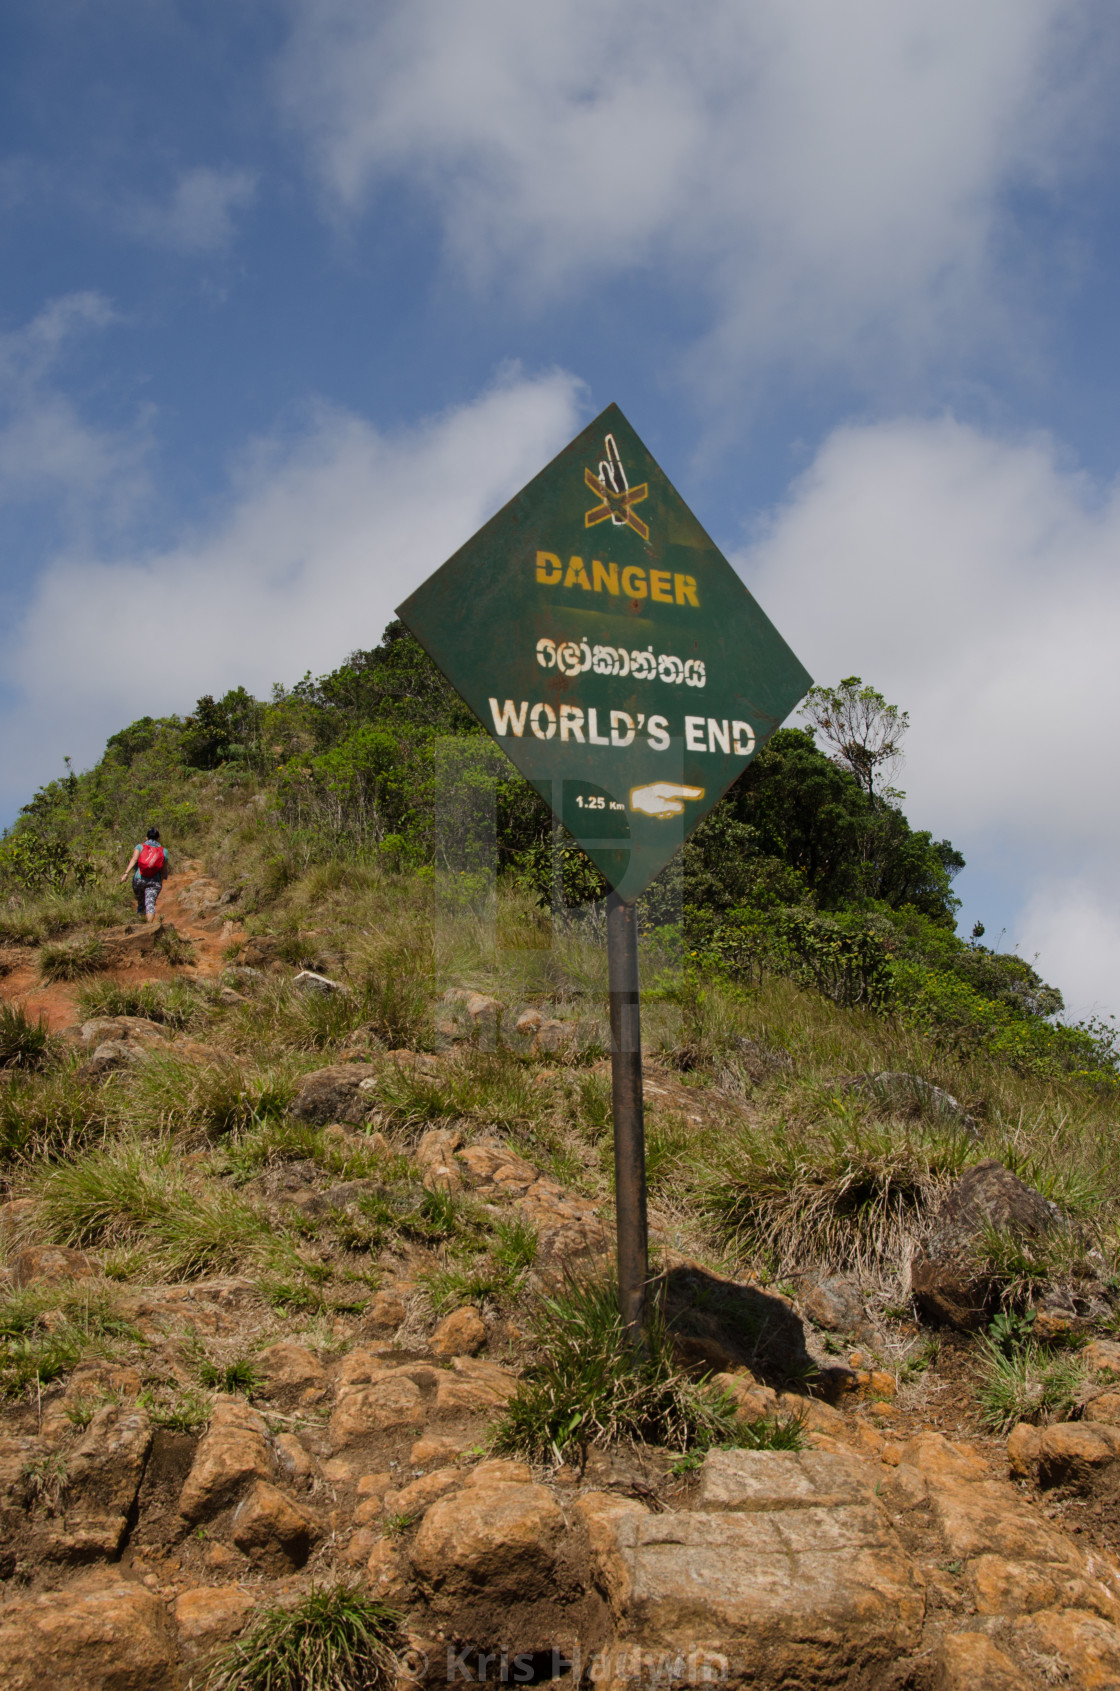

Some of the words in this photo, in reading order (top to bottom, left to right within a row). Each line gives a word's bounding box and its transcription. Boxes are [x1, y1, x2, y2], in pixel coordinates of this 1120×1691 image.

[537, 552, 700, 607] DANGER
[685, 716, 755, 755] END
[575, 795, 606, 810] 1.25
[609, 801, 625, 810] Km
